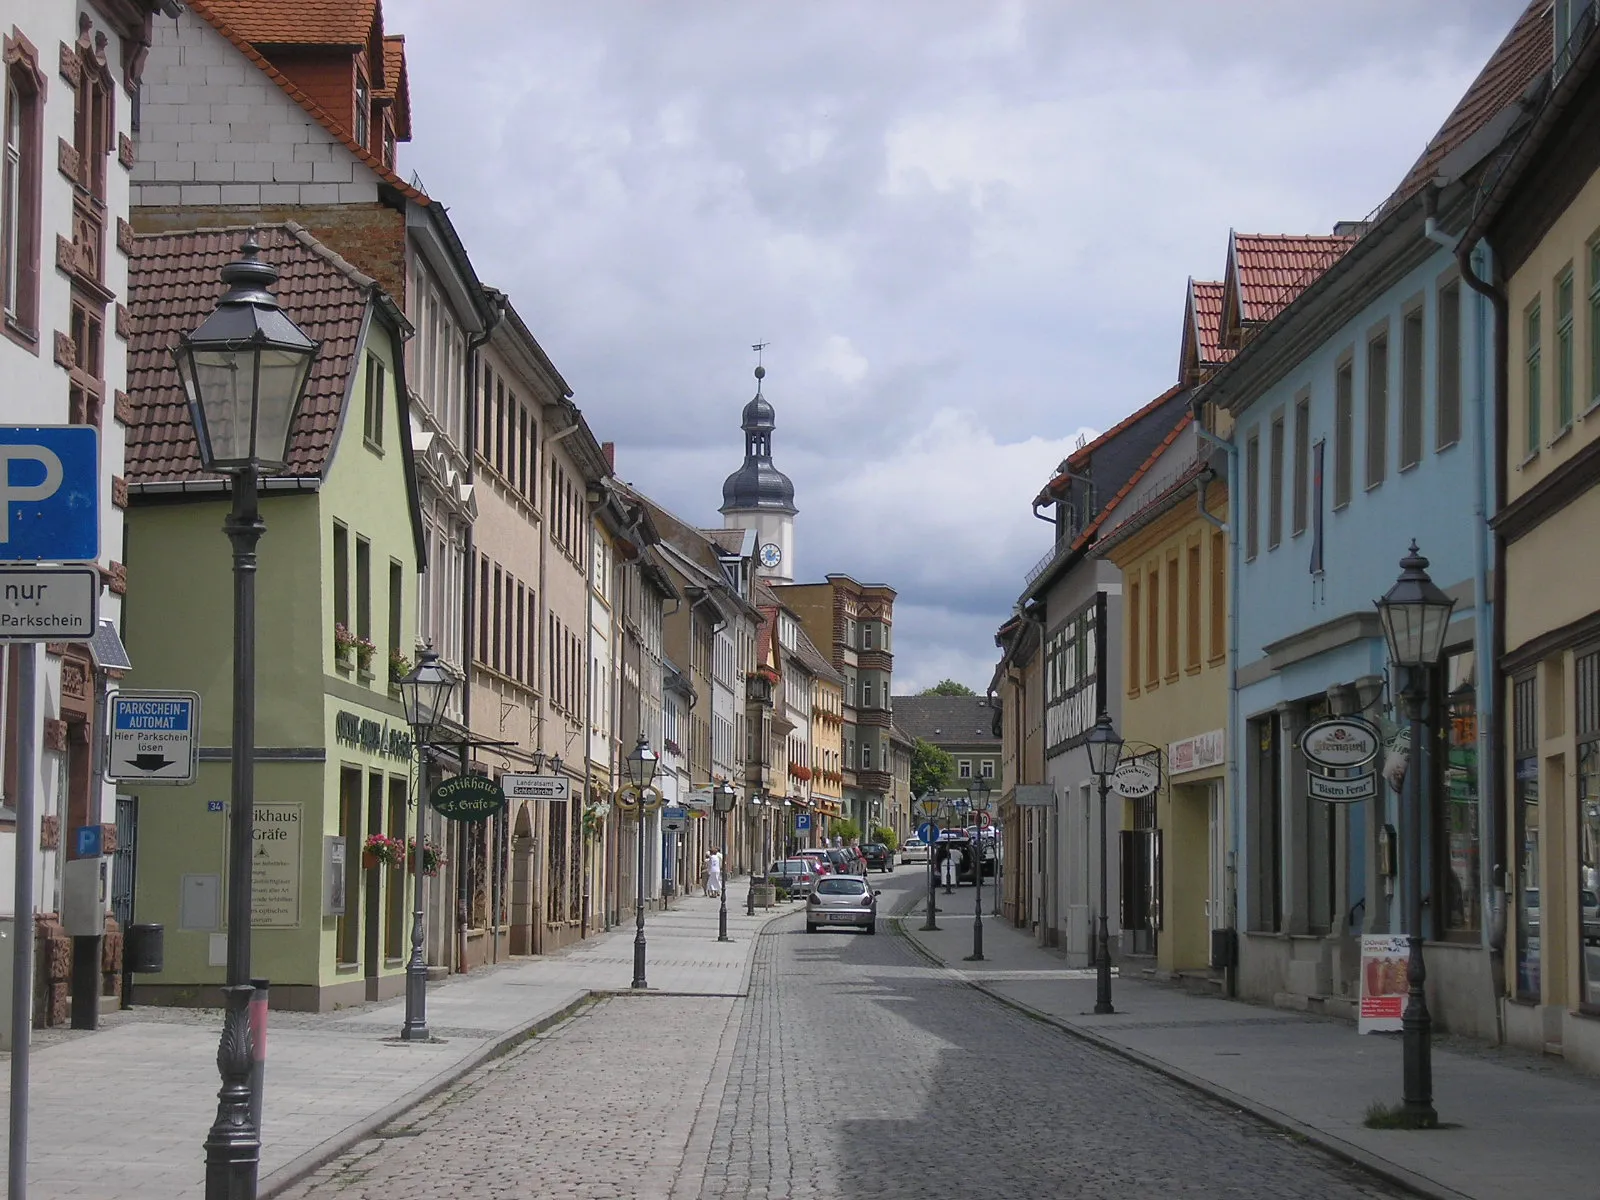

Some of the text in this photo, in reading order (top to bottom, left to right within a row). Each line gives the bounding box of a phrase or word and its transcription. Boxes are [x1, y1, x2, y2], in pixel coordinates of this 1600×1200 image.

[0, 444, 64, 543] P
[5, 584, 48, 600] nur
[1, 613, 82, 627] Parkschein
[119, 702, 187, 715] PARKSCHEIN-
[129, 716, 176, 729] AUTOMAT
[114, 732, 188, 741] Hier Parkschein
[138, 743, 163, 752] lösen
[1115, 767, 1152, 779] Fleischerei
[437, 776, 499, 797] Optikhaus
[516, 779, 554, 787] Landratsamt
[210, 802, 221, 811] 34
[458, 798, 489, 811] Gräfe
[798, 816, 807, 828] P
[252, 828, 288, 840] Gräfe
[79, 829, 96, 855] P
